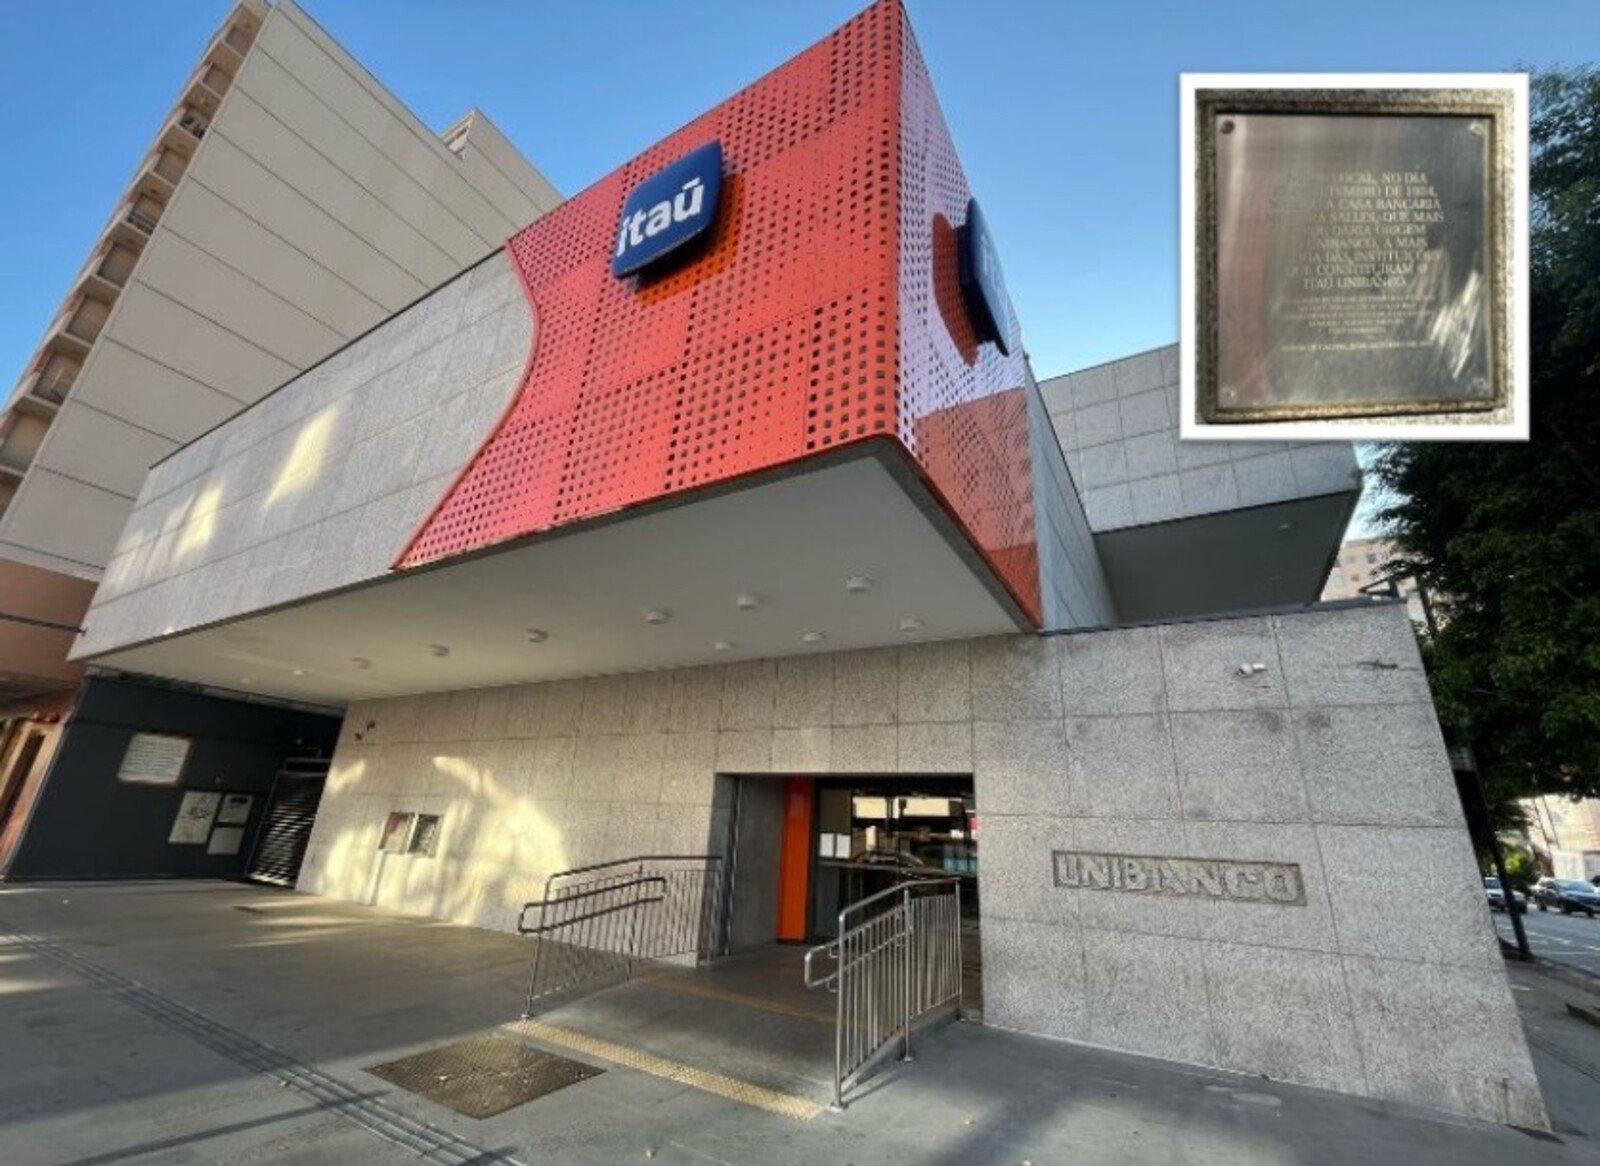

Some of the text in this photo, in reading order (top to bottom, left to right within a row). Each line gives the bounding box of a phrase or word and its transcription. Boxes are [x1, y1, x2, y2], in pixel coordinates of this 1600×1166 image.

[1404, 172, 1427, 184] DIA
[1385, 186, 1401, 198] DE
[1339, 199, 1372, 210] CASA
[1383, 211, 1407, 223] QUE
[1413, 211, 1444, 222] MAIS
[1397, 236, 1429, 248] MAIS
[1056, 853, 1298, 901] UNIBANCO
